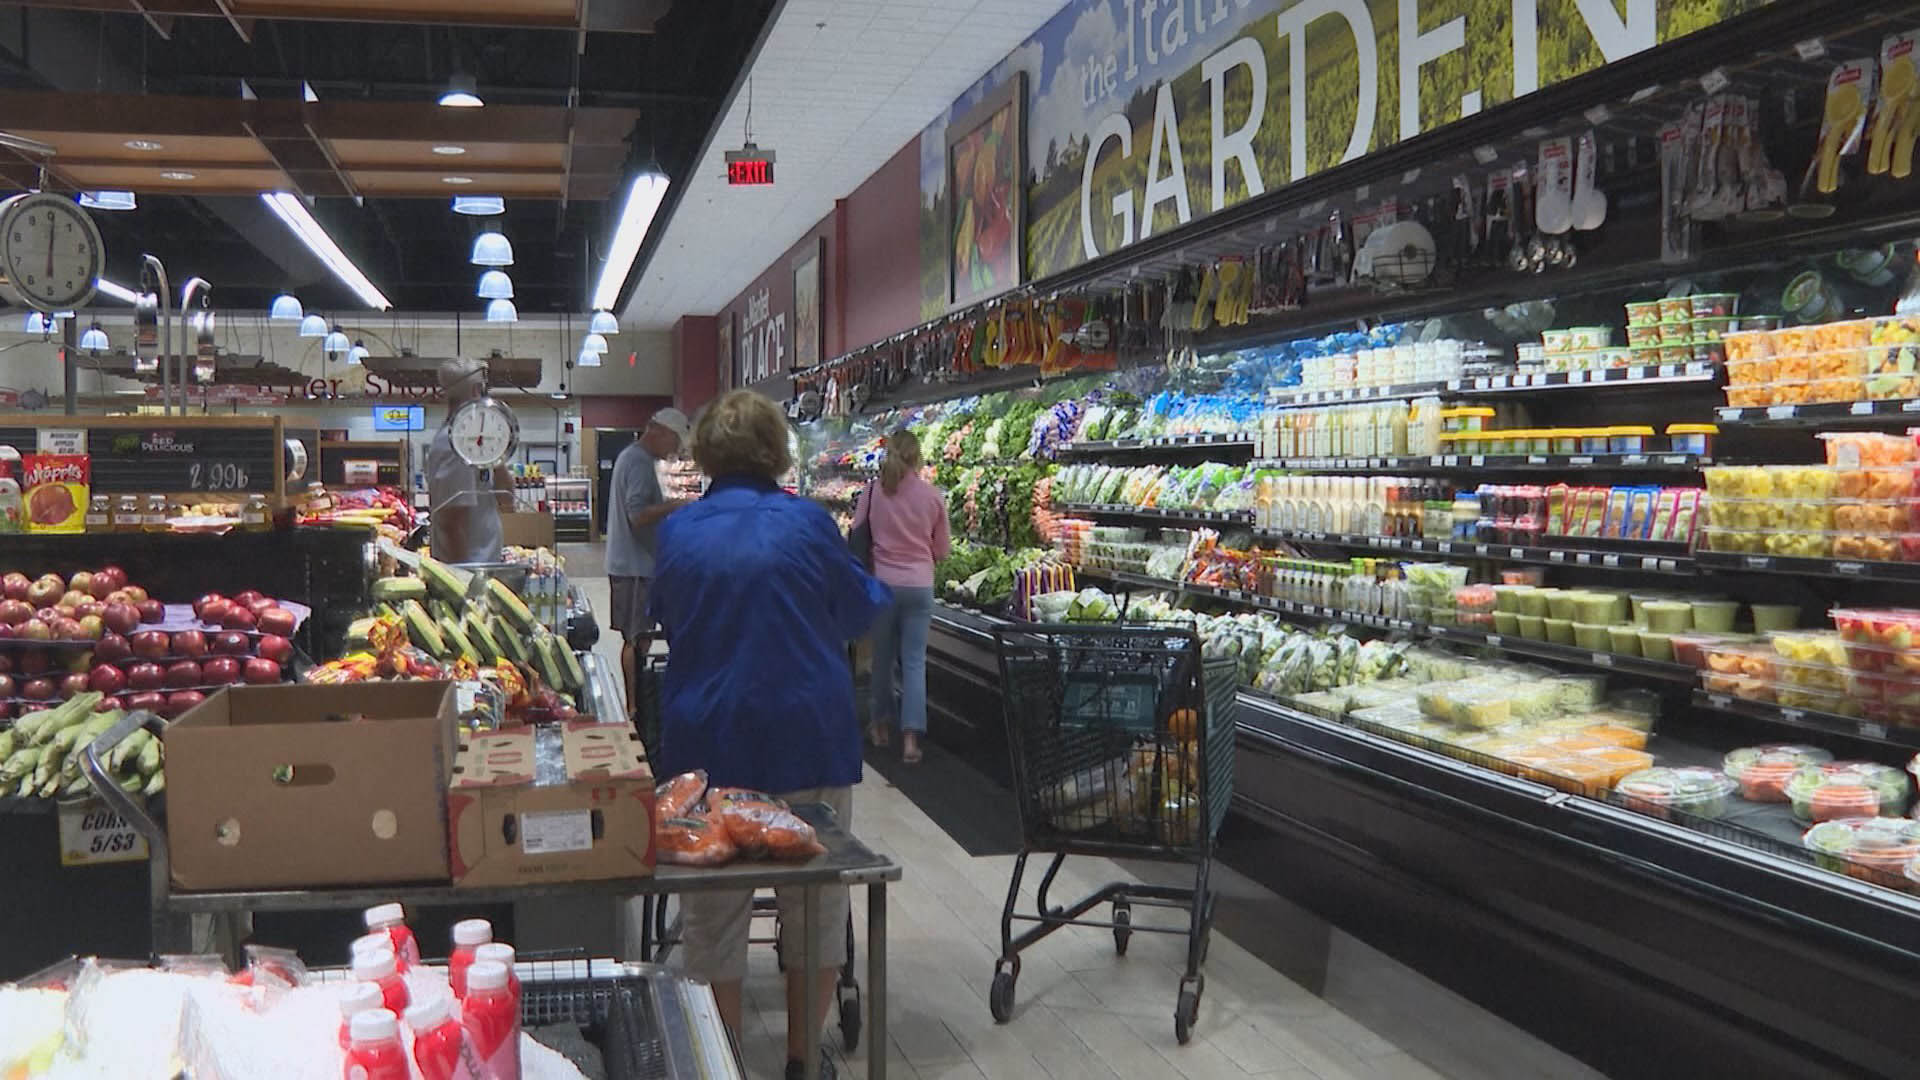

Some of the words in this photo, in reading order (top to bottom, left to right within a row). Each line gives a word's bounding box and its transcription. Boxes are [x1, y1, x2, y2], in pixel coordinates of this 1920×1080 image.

[1080, 49, 1118, 107] the
[1081, 0, 1657, 260] GARDEN
[736, 161, 768, 183] EXIT
[47, 210, 55, 221] 0
[64, 223, 72, 232] 1
[78, 243, 86, 254] 2
[15, 256, 22, 265] 7
[65, 281, 73, 290] 4
